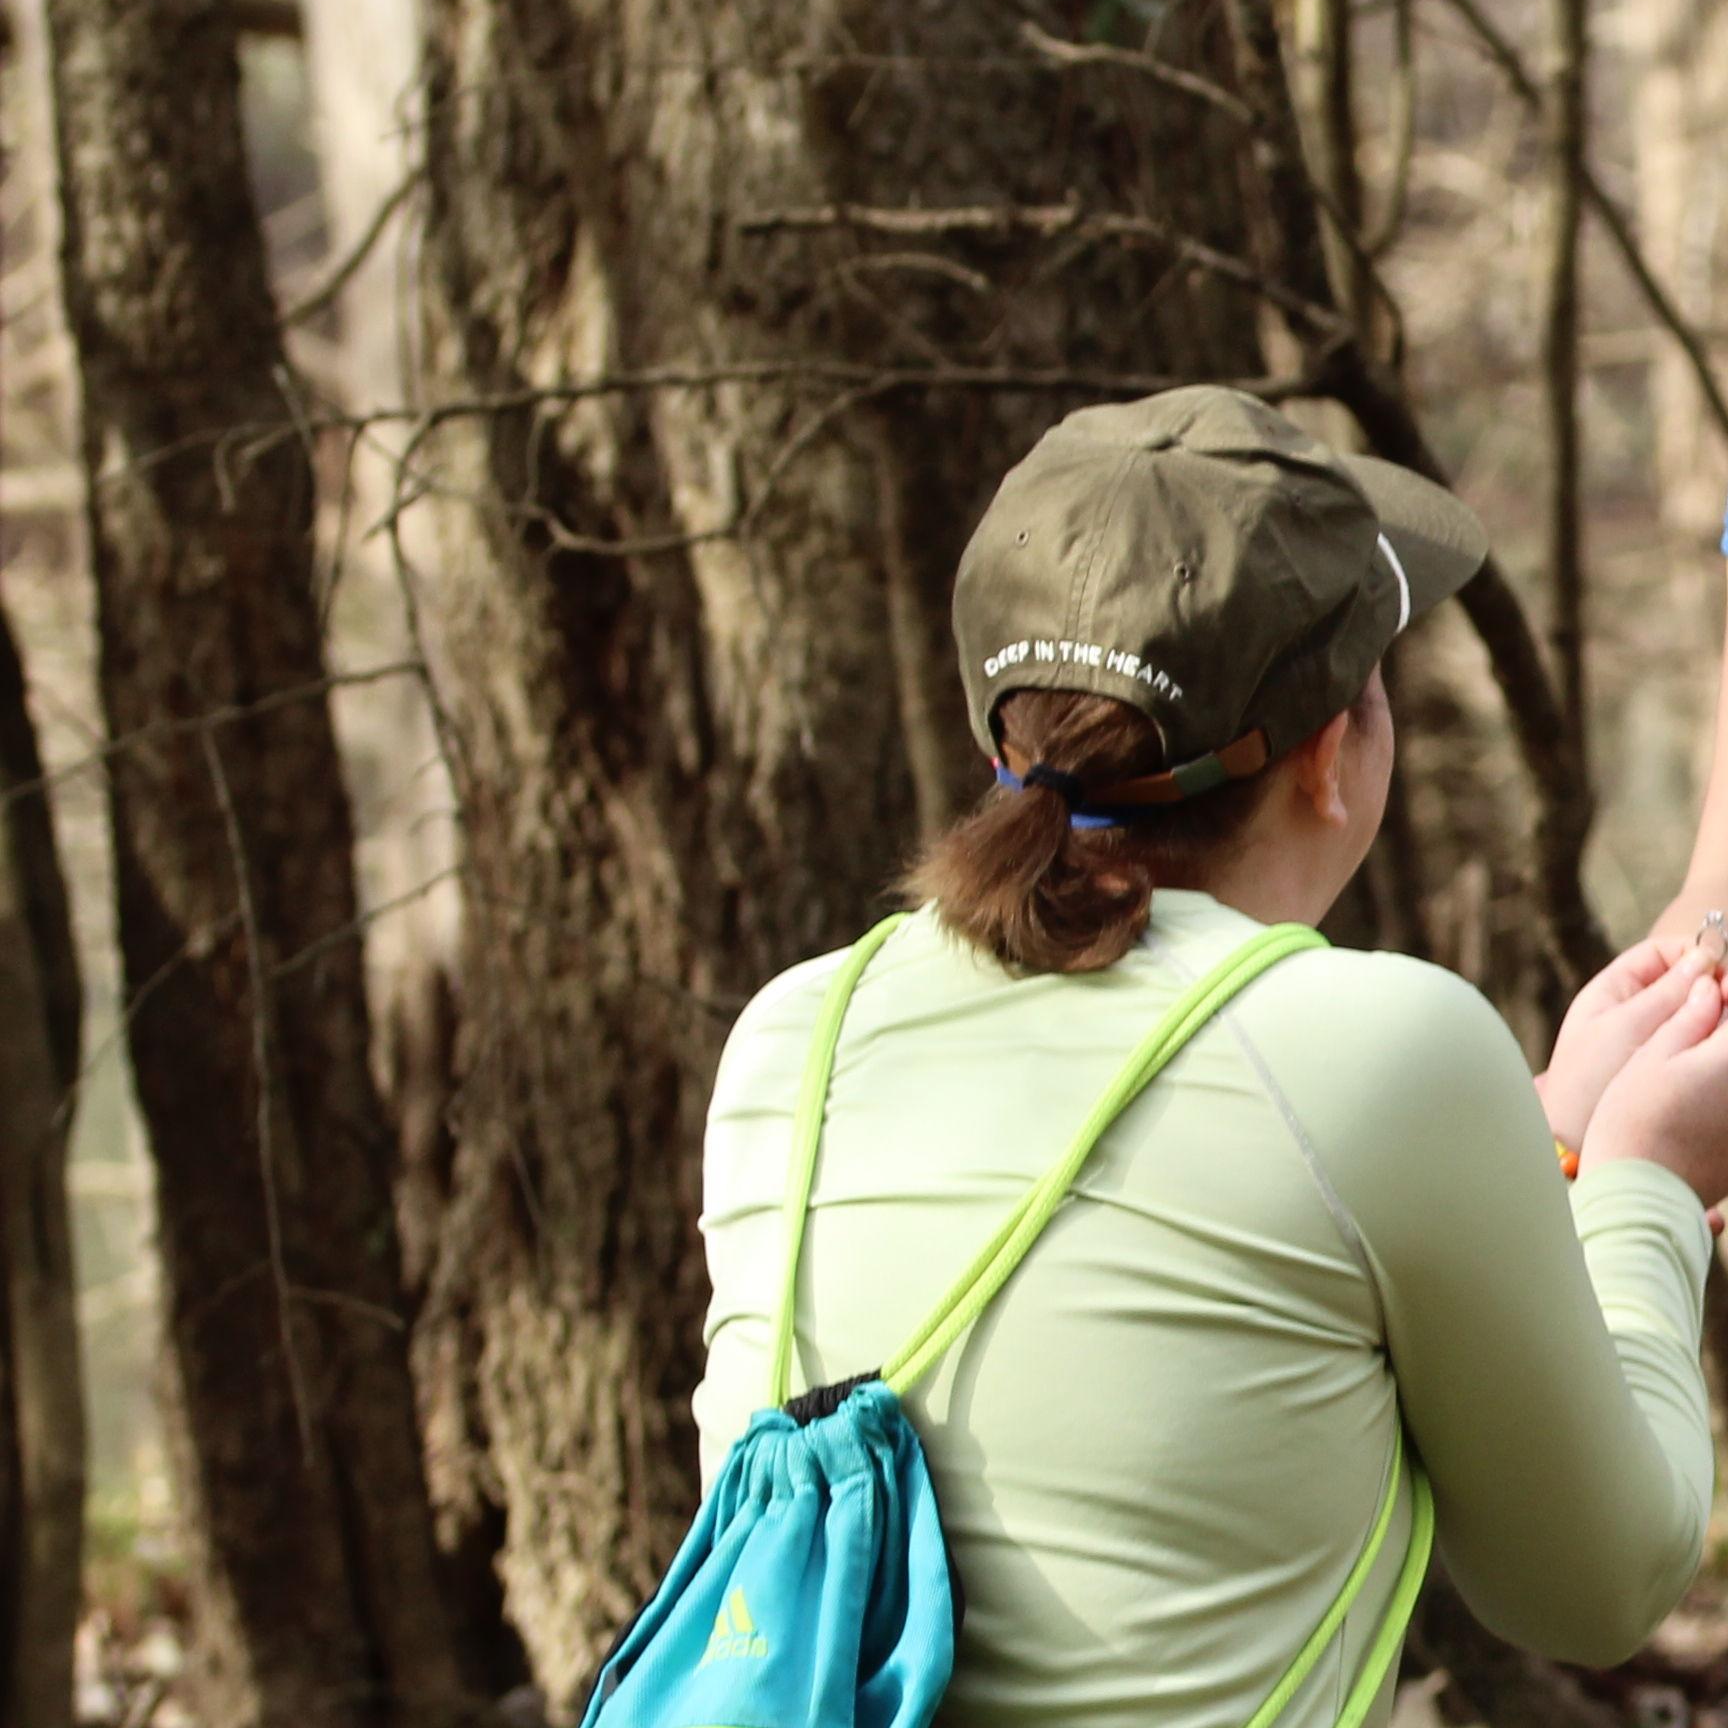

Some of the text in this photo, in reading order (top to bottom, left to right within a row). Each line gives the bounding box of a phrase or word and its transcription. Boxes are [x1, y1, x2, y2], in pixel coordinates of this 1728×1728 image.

[983, 639, 1184, 702] DEEP IN THE HEART
